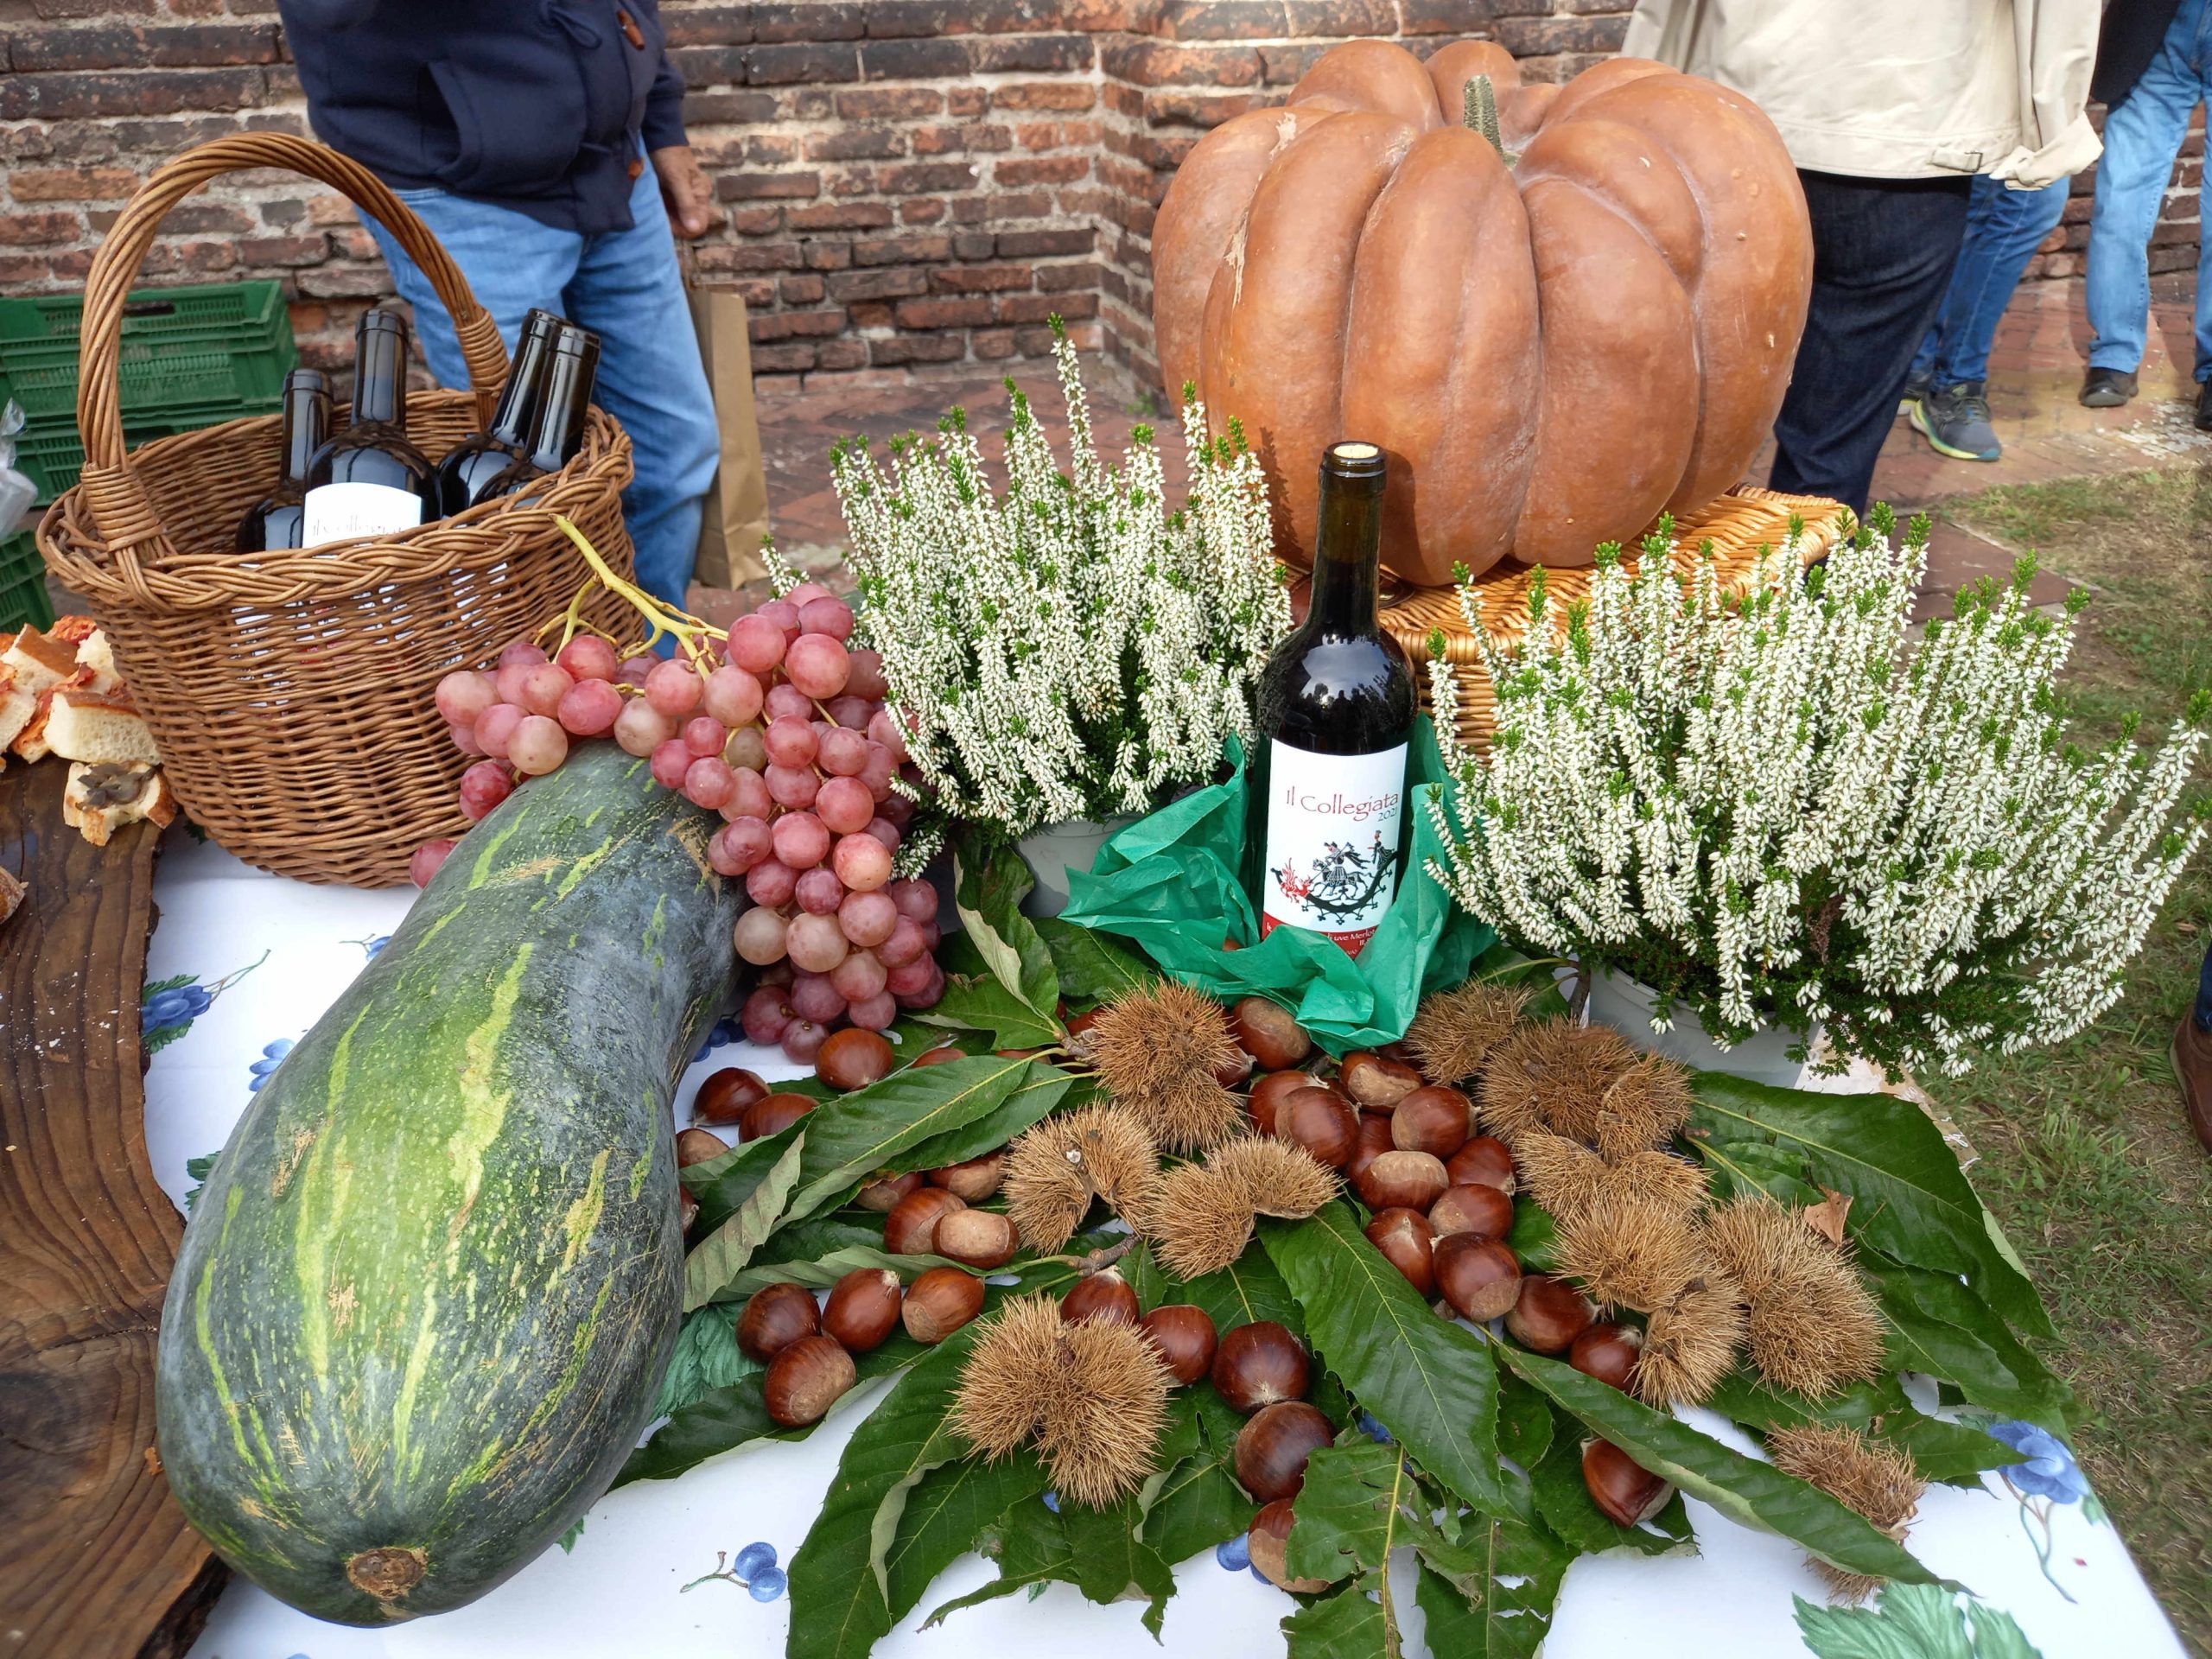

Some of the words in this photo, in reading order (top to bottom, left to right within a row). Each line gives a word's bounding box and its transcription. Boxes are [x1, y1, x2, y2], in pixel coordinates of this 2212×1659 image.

[1287, 785, 1295, 805] Il
[1300, 793, 1398, 822] Collegiata
[1377, 806, 1398, 822] 2021
